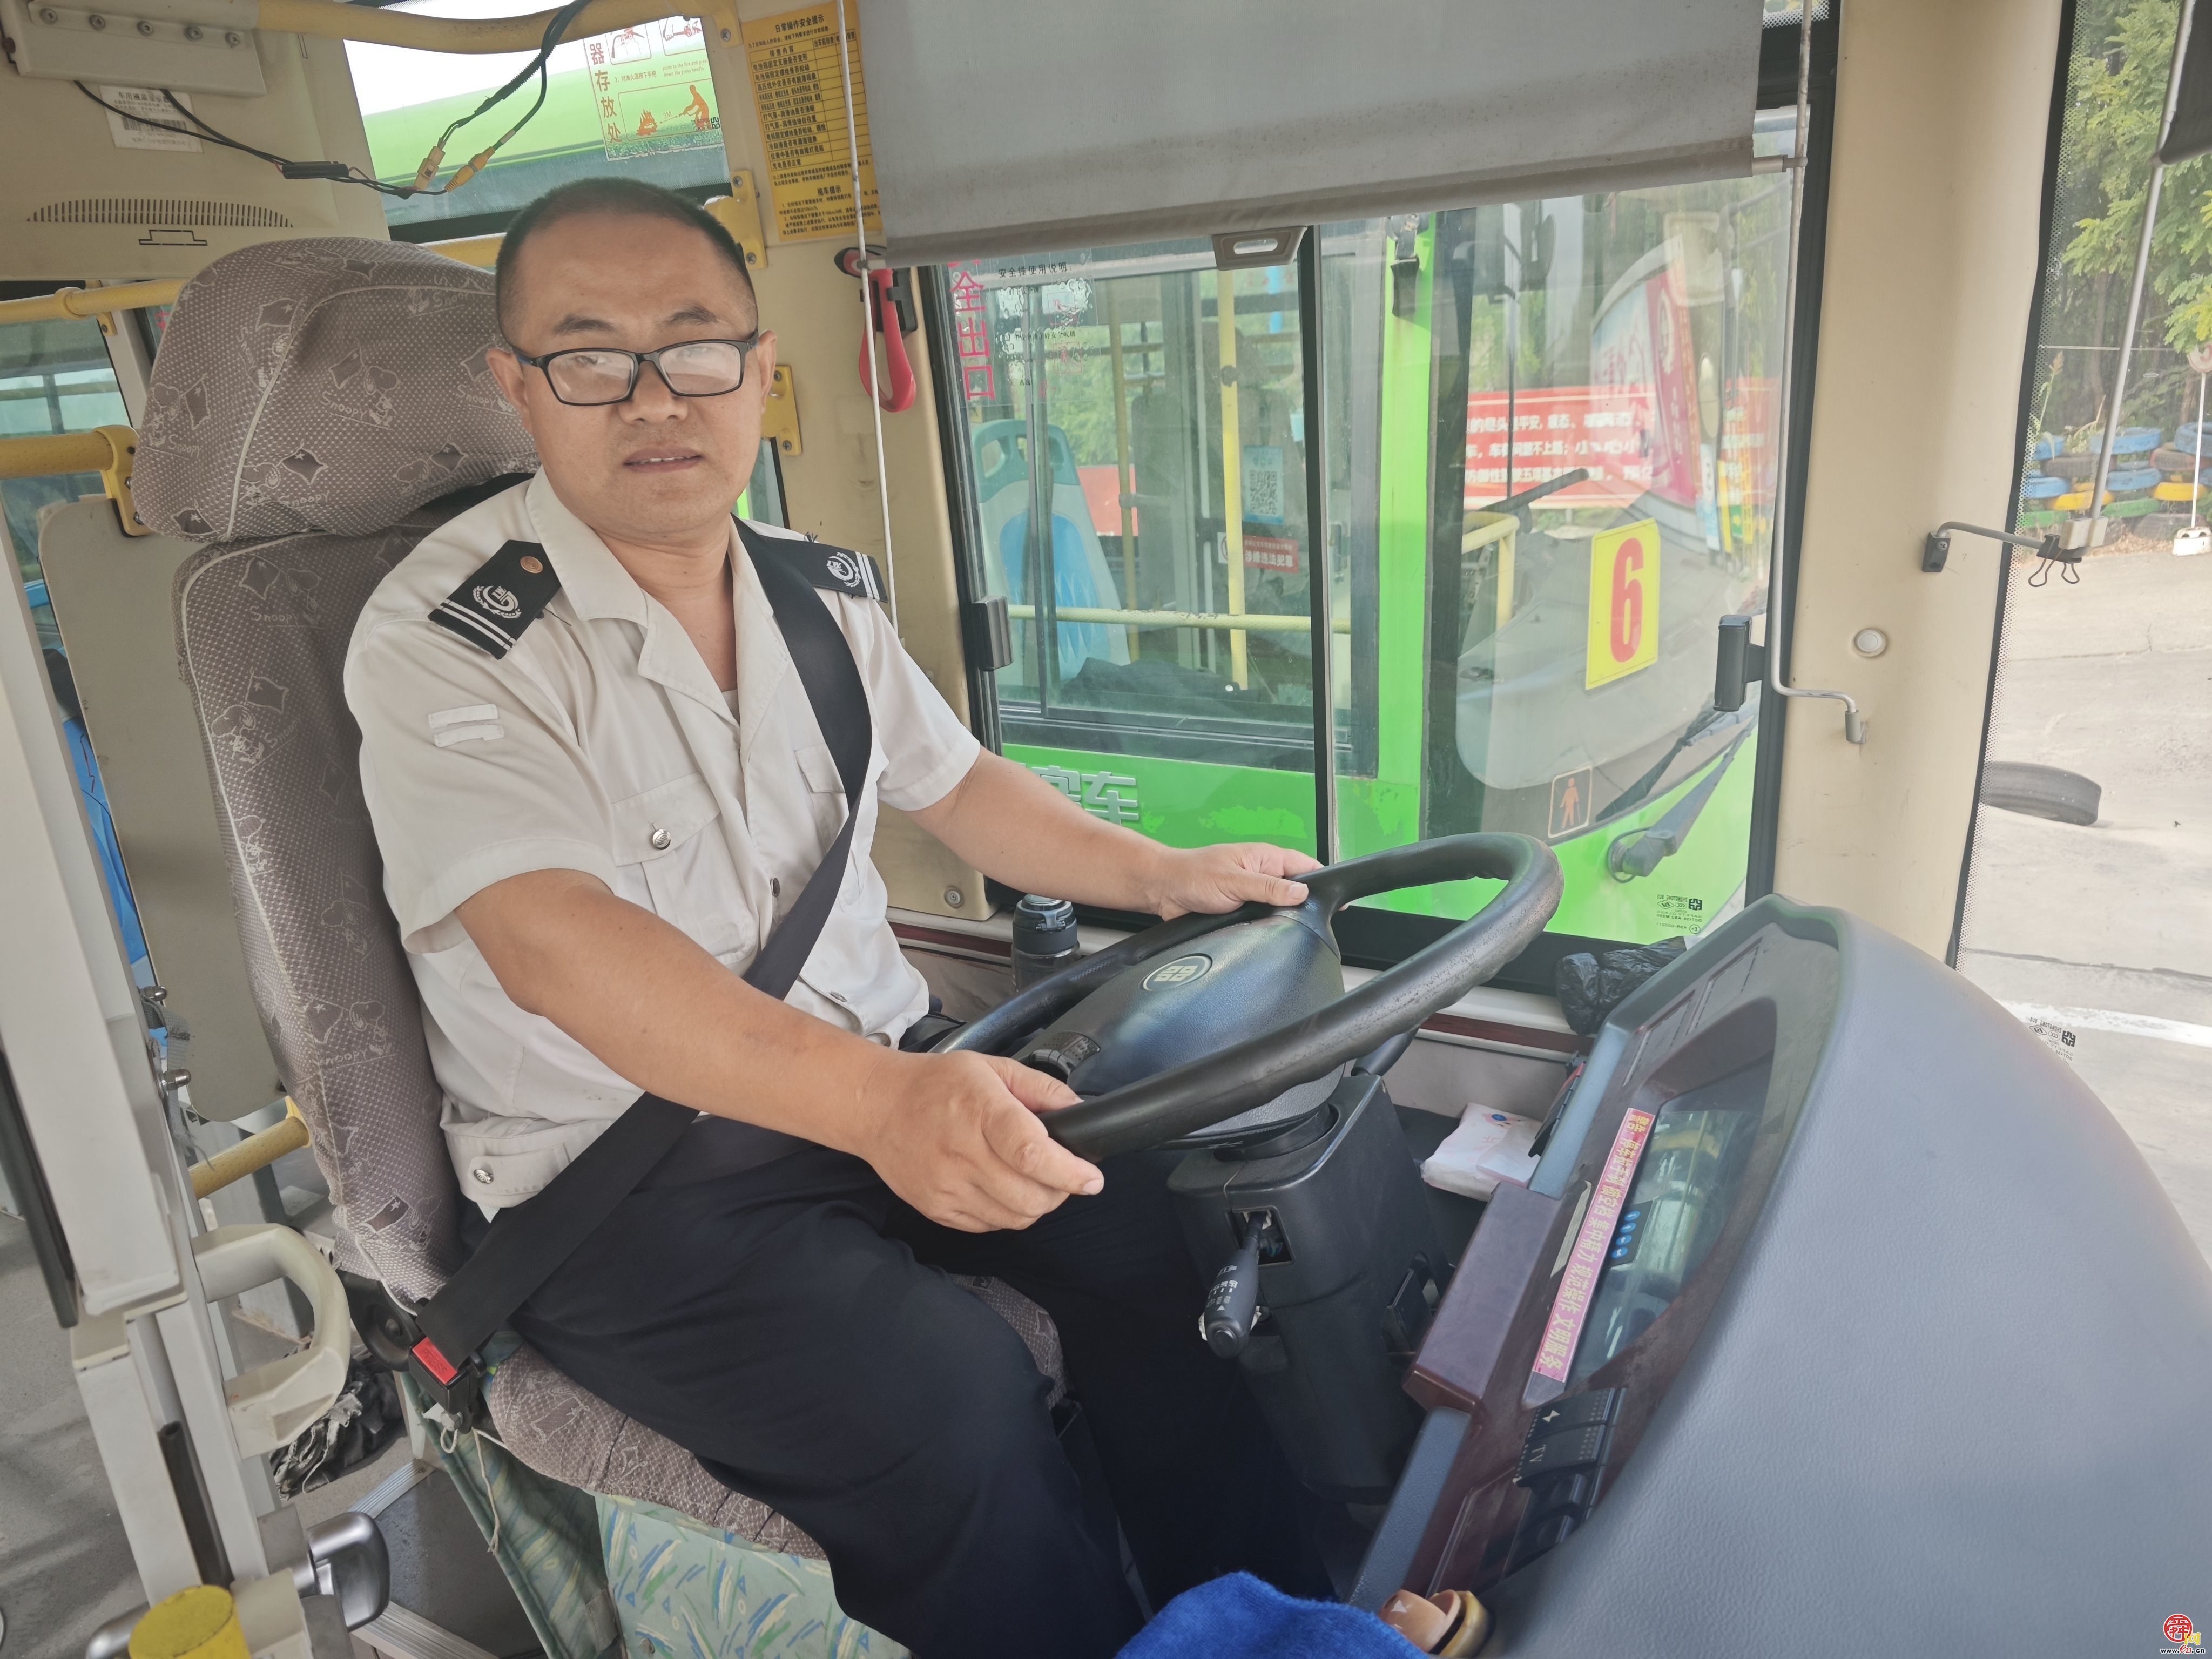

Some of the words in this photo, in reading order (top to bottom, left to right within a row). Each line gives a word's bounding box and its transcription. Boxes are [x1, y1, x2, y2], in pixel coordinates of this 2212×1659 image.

[775, 14, 824, 33] 日常操作安全提示
[589, 42, 623, 144] 器存放处
[817, 185, 841, 197] 拖车提示
[947, 259, 995, 401] 全出口
[1610, 538, 1644, 663] 6
[1577, 1216, 1611, 1264] 集中精力
[1559, 1264, 1595, 1315] 规范操作
[1539, 1313, 1576, 1371] 文明服务
[1529, 1444, 1546, 1462] TV
